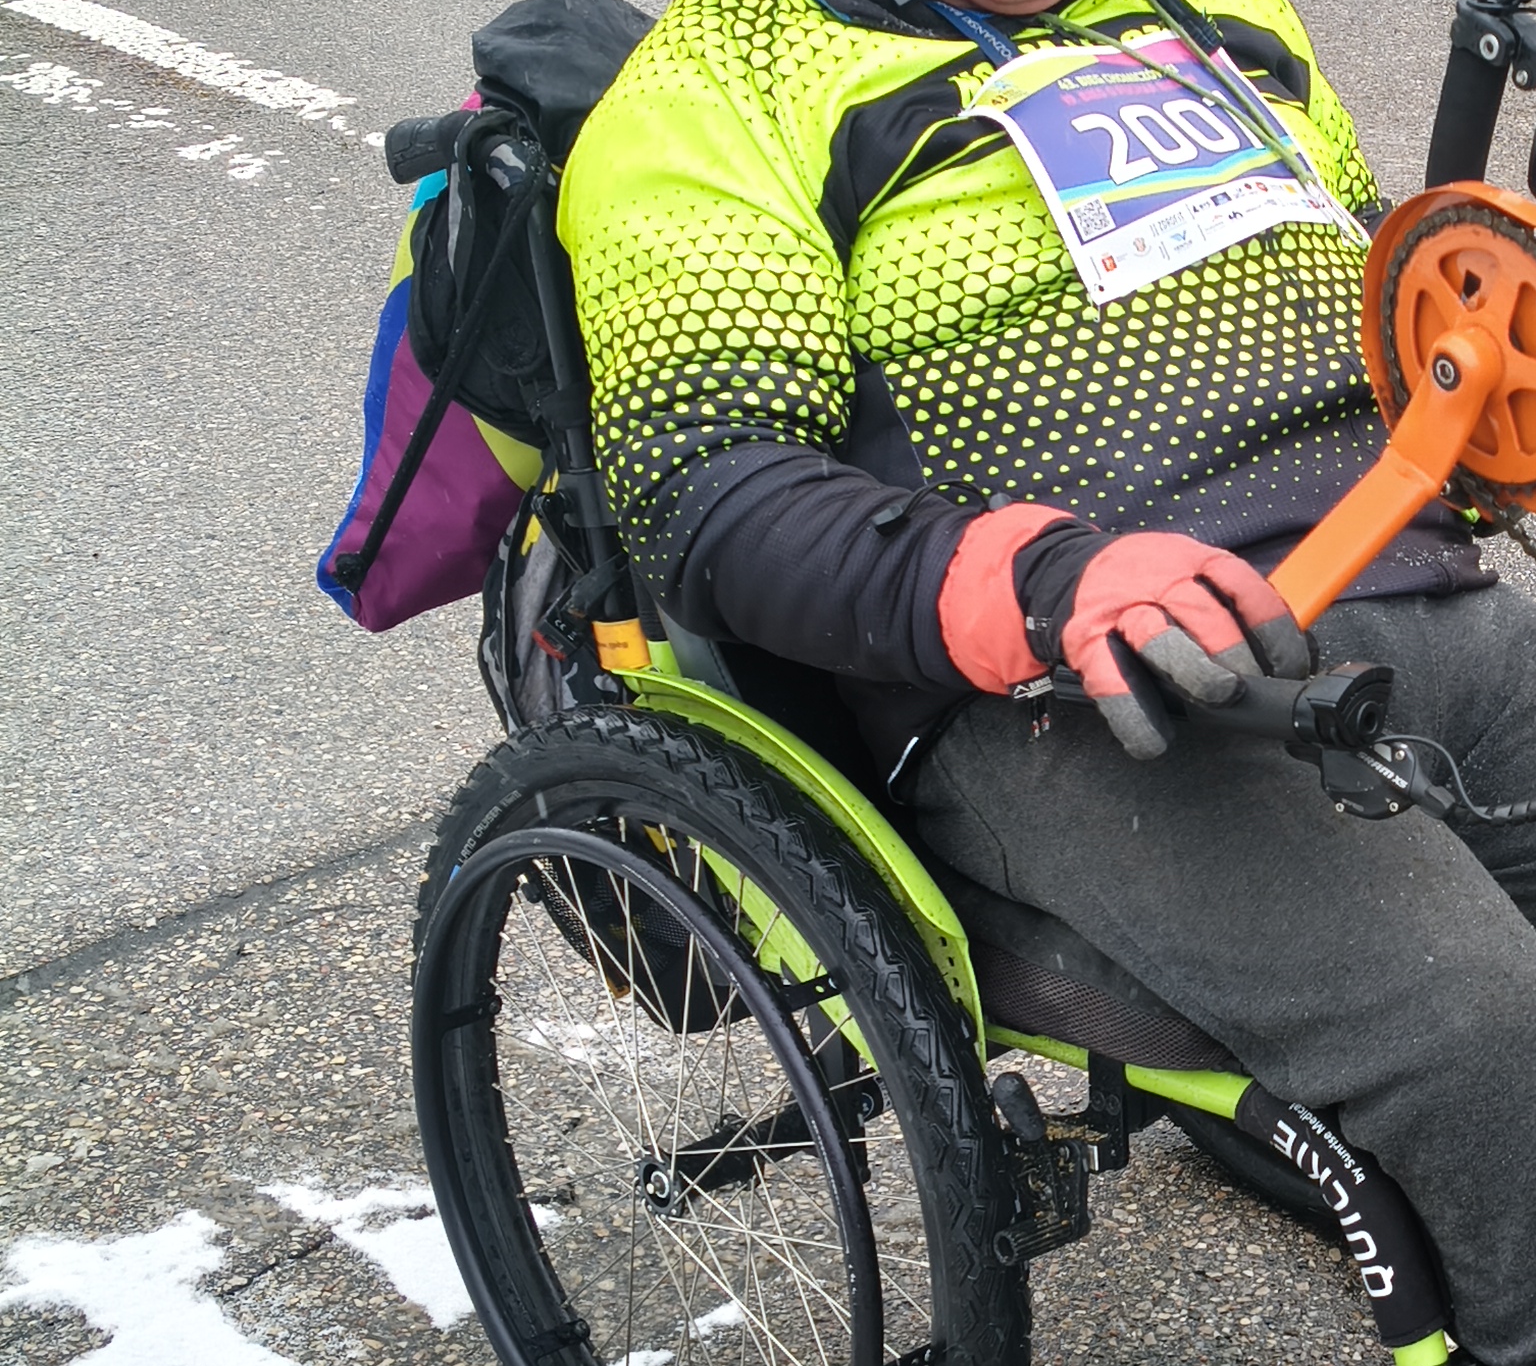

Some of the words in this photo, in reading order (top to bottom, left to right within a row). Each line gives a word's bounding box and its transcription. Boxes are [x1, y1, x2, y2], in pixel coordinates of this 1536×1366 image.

[1357, 750, 1395, 780] SRAM
[457, 837, 477, 864] LAND
[473, 805, 503, 838] CRUISER
[1288, 1102, 1327, 1136] Medical
[1323, 1131, 1356, 1170] Sunrise
[1351, 1167, 1366, 1185] by
[1272, 1119, 1395, 1298] QUICKIE
